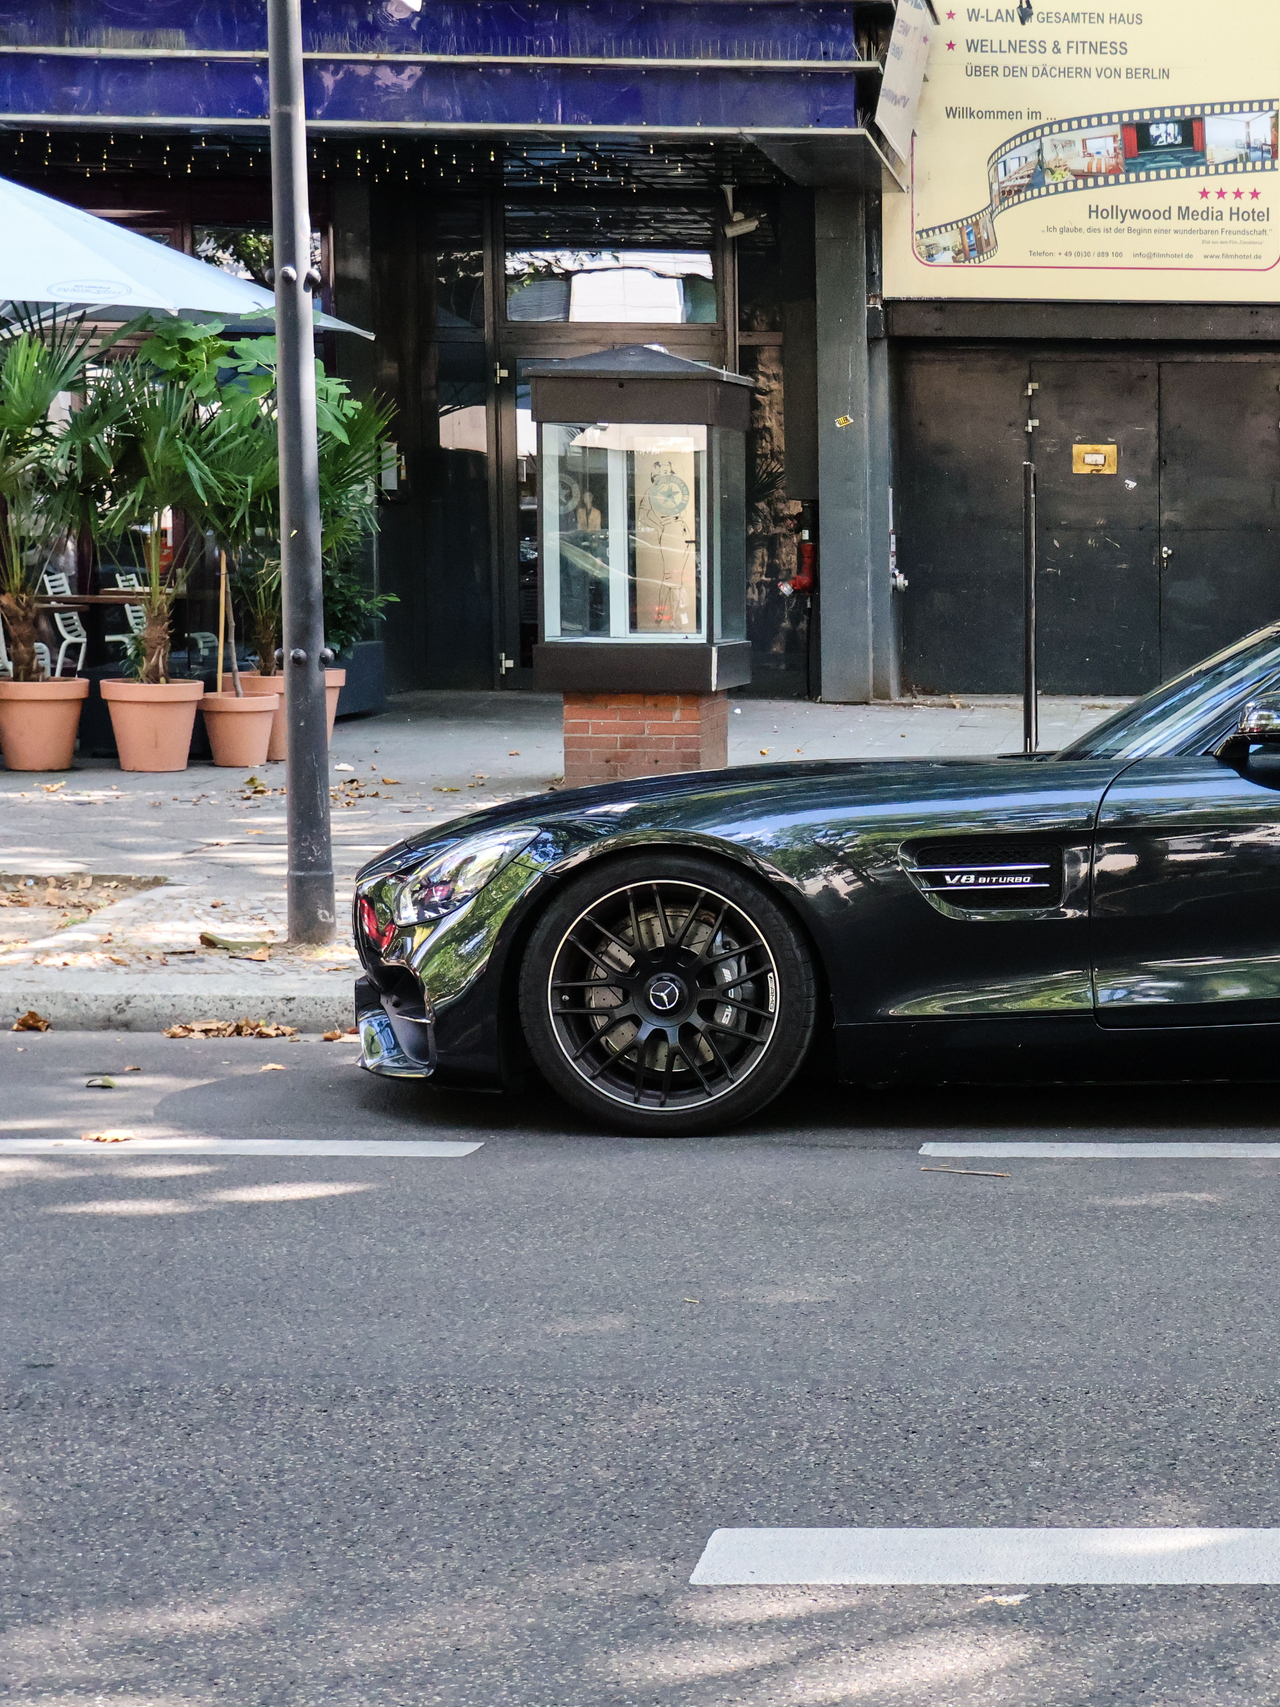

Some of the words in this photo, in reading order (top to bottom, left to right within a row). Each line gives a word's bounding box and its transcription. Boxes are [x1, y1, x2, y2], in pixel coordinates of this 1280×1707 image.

[967, 8, 1015, 23] W-LAN
[1036, 11, 1105, 25] GESAMTEN
[1109, 13, 1143, 25] HAUS
[965, 39, 1047, 54] WELLNESS
[1051, 40, 1062, 54] &
[1066, 41, 1128, 55] FITNESS
[965, 62, 999, 78] ÜBER
[1002, 66, 1028, 78] DEN
[1031, 63, 1092, 79] DÄCHERN
[1096, 67, 1122, 79] VON
[1125, 67, 1170, 80] BERLIN
[945, 106, 1023, 121] Willkommen
[1027, 107, 1042, 121] im
[1087, 204, 1172, 223] Hollywood
[1177, 205, 1224, 221] Media
[1228, 206, 1270, 222] Hotel
[1058, 226, 1085, 235] glaube,
[1103, 226, 1112, 234] ist
[1127, 227, 1152, 236] Beginn
[1173, 227, 1219, 235] wunderbaren
[1132, 251, 1194, 260] info@filmhotel.de
[944, 874, 975, 884] V8
[978, 876, 1032, 884] BITURBO
